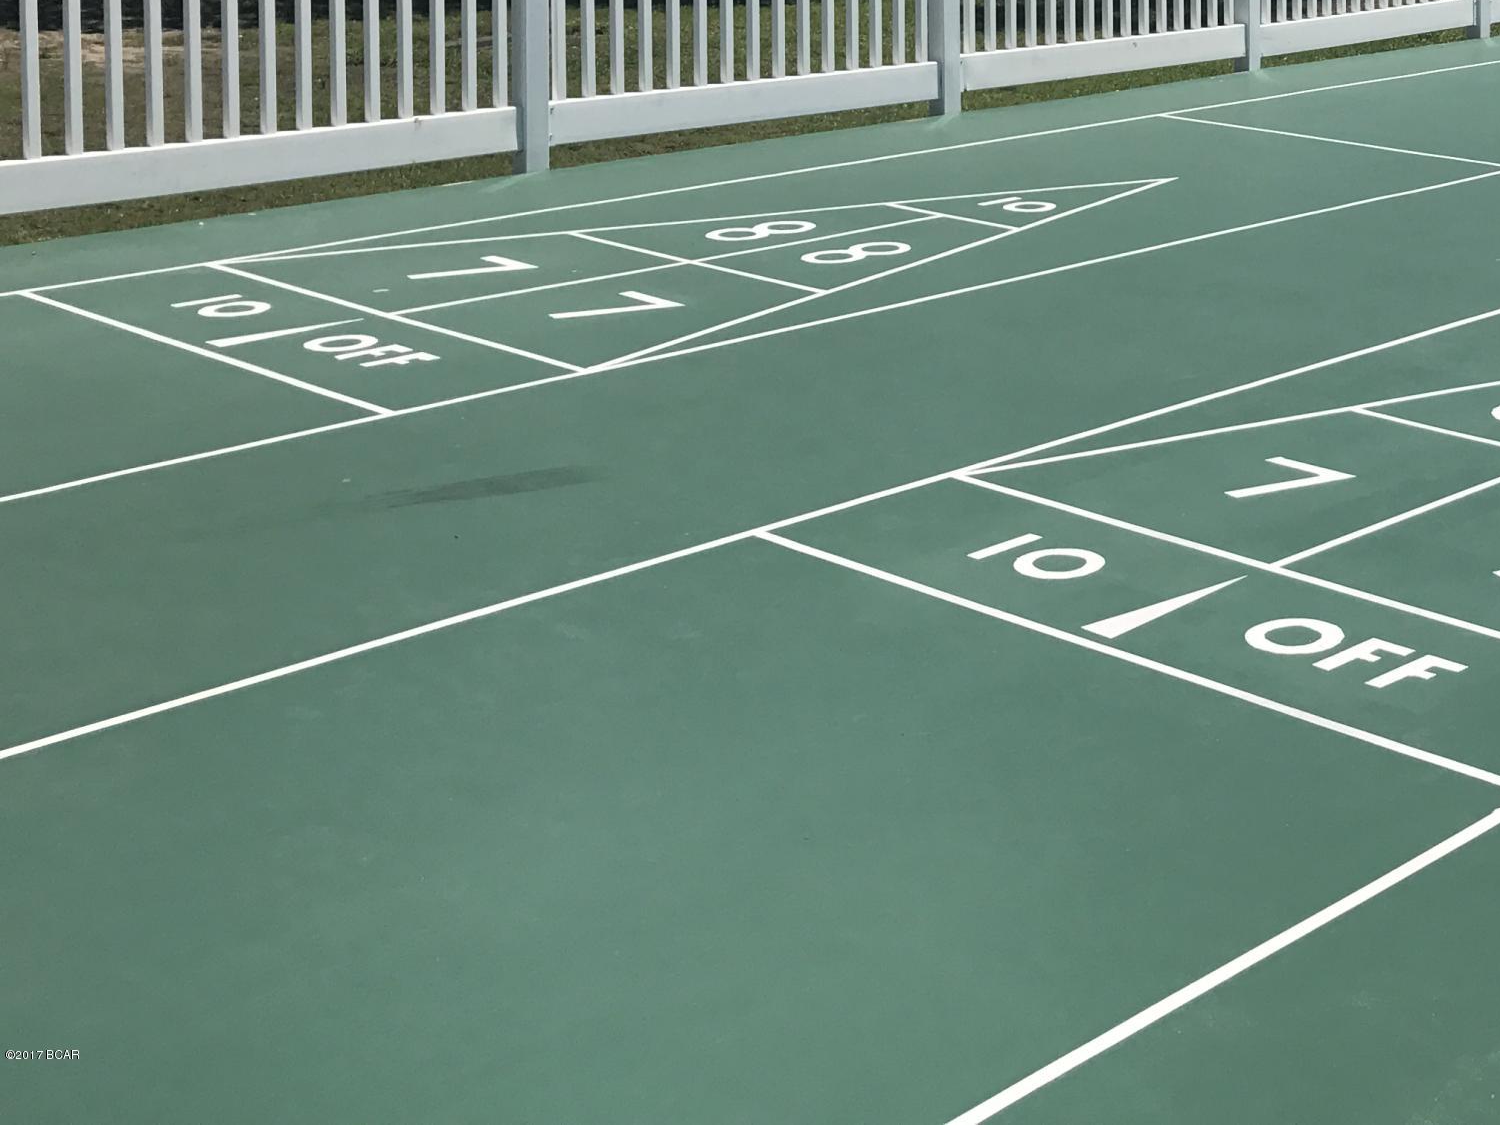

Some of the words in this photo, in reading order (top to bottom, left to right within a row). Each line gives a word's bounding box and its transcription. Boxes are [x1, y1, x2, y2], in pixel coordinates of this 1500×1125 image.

[977, 196, 1057, 213] 10
[704, 220, 817, 242] 8
[800, 241, 912, 265] 8
[406, 255, 539, 280] 7
[547, 290, 686, 320] 7
[170, 293, 272, 318] 10
[302, 333, 441, 368] OFF
[1223, 456, 1357, 499] 7
[966, 532, 1106, 580] 10
[1244, 617, 1469, 689] OFF
